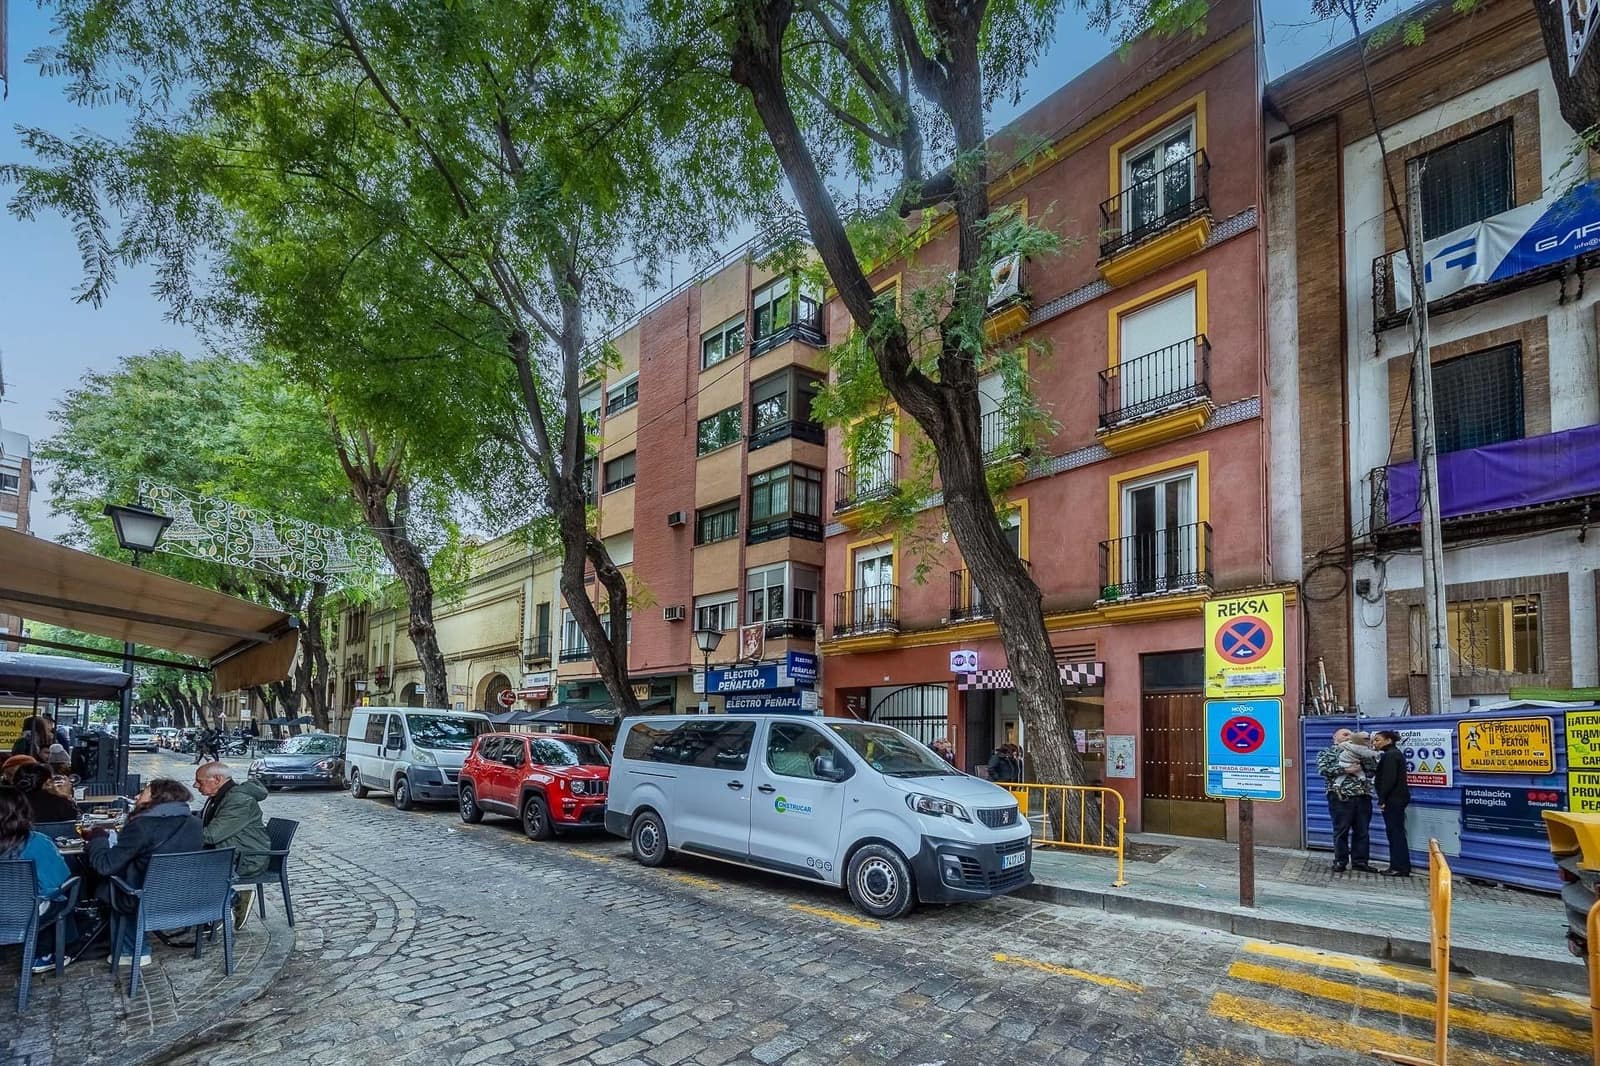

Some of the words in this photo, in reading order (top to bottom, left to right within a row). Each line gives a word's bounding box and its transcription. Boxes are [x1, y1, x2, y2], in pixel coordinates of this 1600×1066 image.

[1217, 599, 1269, 617] REKSA
[723, 669, 759, 680] ELECTRO
[718, 678, 766, 691] PEÑAFLOR
[726, 699, 761, 708] ELECTRO
[1568, 715, 1600, 726] ¡¡ATEN
[1495, 722, 1541, 734] PRECAUCIÓN
[1571, 729, 1600, 738] TRAM
[1501, 736, 1529, 747] PEATÓN
[1508, 759, 1549, 767] CAMIONES
[1465, 788, 1511, 798] Instalación
[1465, 798, 1507, 807] protegida
[1527, 800, 1558, 808] Securitas
